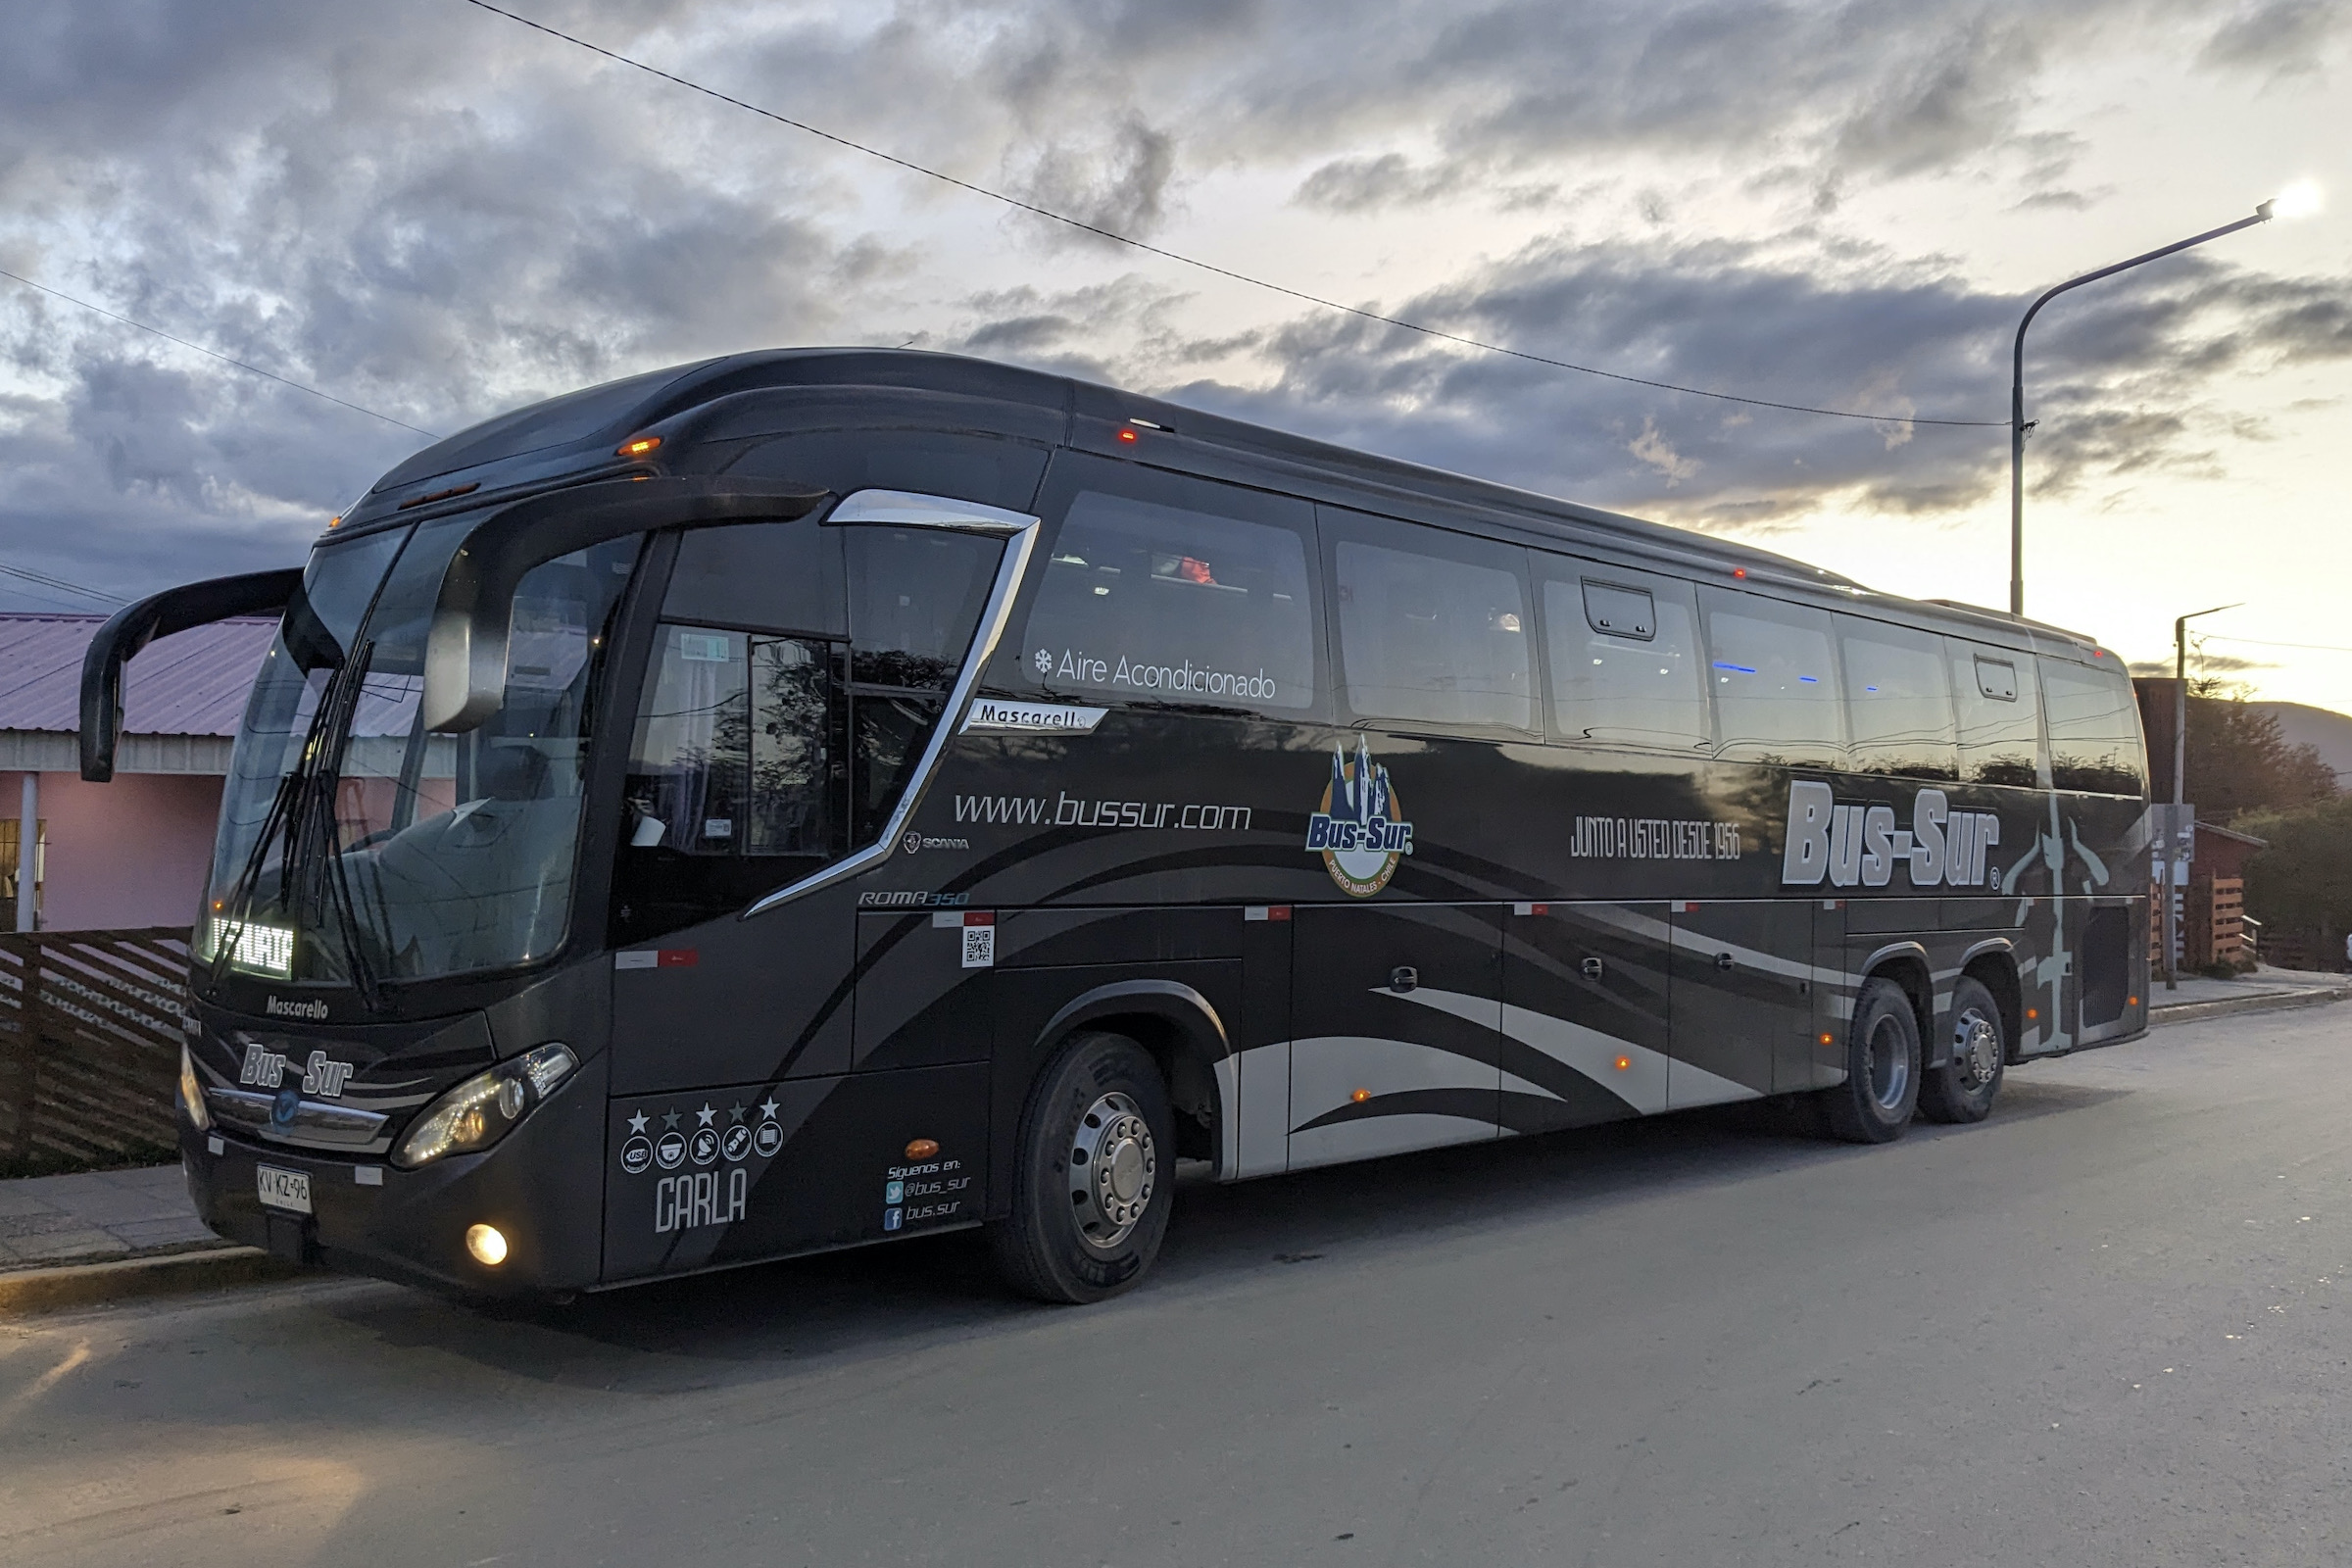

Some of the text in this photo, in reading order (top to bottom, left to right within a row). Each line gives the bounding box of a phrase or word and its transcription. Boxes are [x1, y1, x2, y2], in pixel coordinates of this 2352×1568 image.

[1056, 648, 1276, 699] Aire Acondicionado
[955, 791, 1251, 830] www.bussur.com
[922, 837, 970, 850] SCANIA
[1306, 813, 1412, 851] Bus-Sur
[1571, 816, 1740, 860] JUNTO A USTED DESDE 1956
[1782, 780, 1999, 887] Bus-Sur
[1329, 859, 1350, 889] PUERTO
[1350, 881, 1378, 895] NATALES
[1381, 857, 1396, 882] CHILE
[267, 995, 328, 1019] Mascarello
[240, 1044, 354, 1097] Bus Sur
[629, 1149, 648, 1159] USB
[944, 1160, 961, 1171] en:
[656, 1168, 747, 1233] CARLA
[905, 1177, 971, 1197] @bus_sur
[906, 1201, 960, 1220] bus.sur
